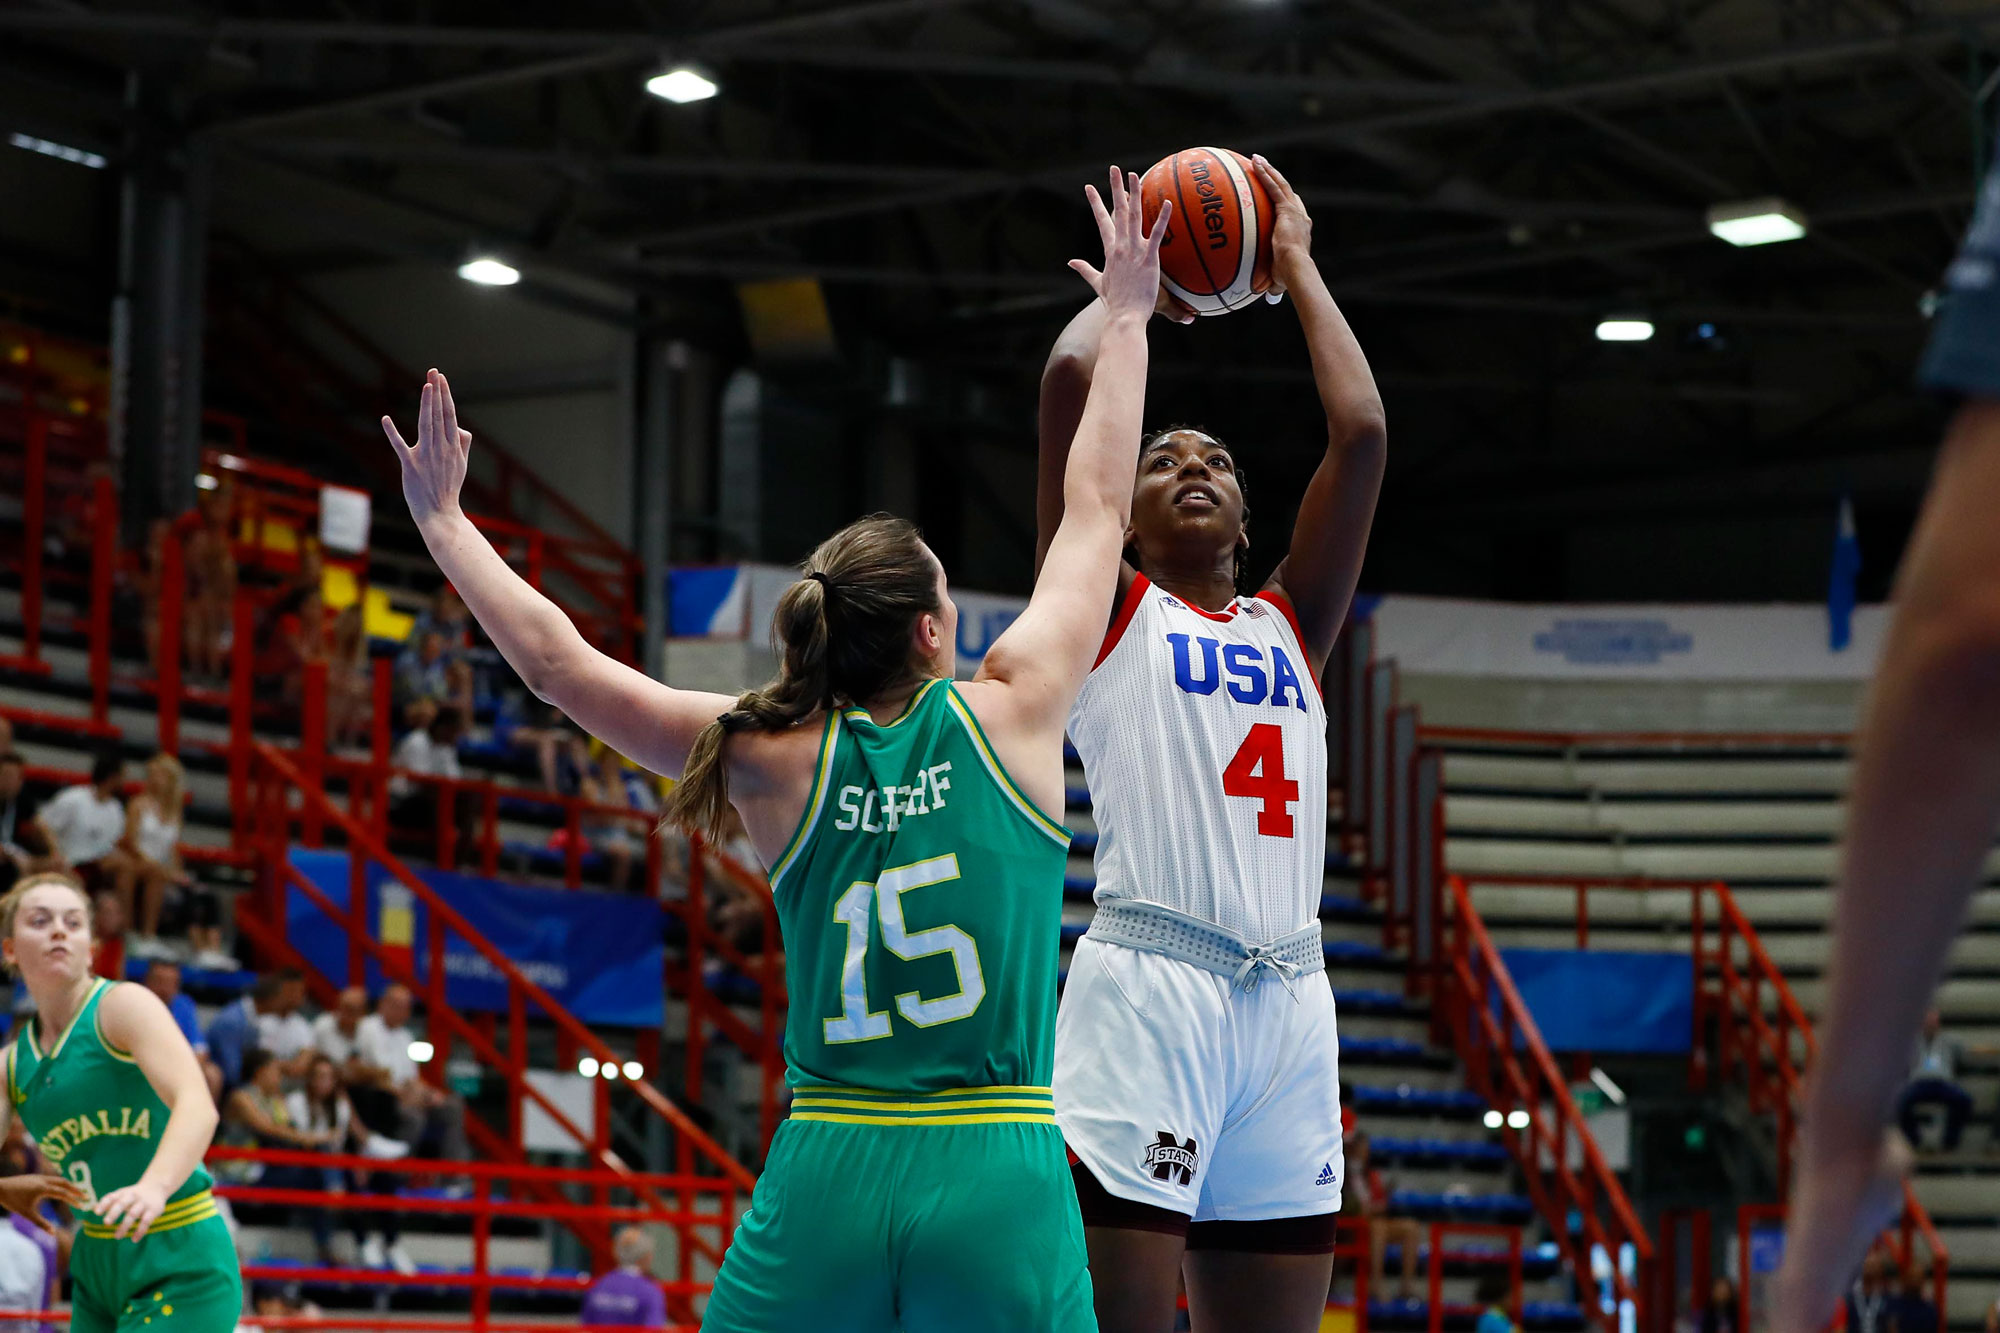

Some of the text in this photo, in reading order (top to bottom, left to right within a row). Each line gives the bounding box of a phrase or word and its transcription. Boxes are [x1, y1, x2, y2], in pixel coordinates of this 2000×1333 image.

[1188, 161, 1229, 249] molten
[1166, 633, 1306, 713] USA
[1223, 723, 1299, 838] 4
[823, 853, 987, 1044] 15
[1158, 1149, 1194, 1169] STATE
[1315, 1175, 1337, 1186] adidas
